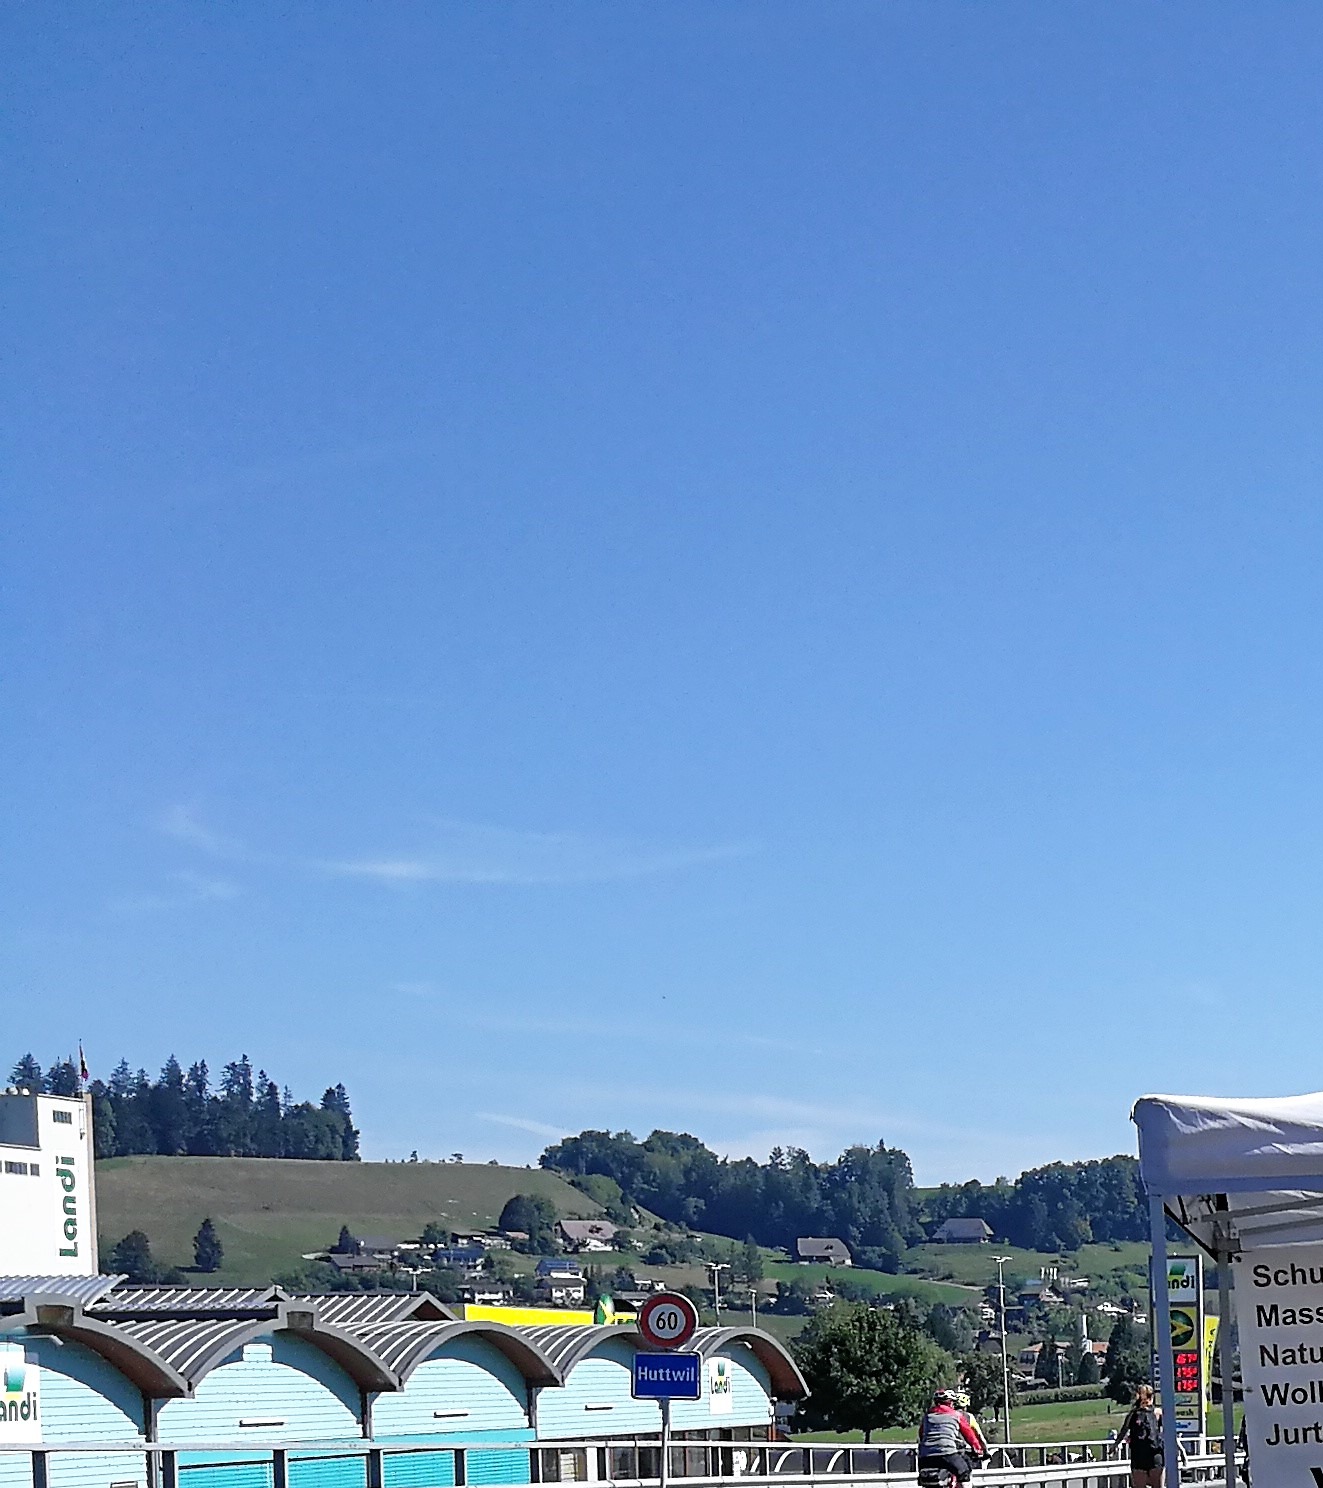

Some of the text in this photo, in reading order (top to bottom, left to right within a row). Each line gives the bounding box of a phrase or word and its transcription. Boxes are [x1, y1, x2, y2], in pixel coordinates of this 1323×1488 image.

[56, 1156, 78, 1257] Landi
[1168, 1275, 1195, 1289] ndi
[656, 1312, 678, 1330] 60
[638, 1366, 695, 1382] Huttwil
